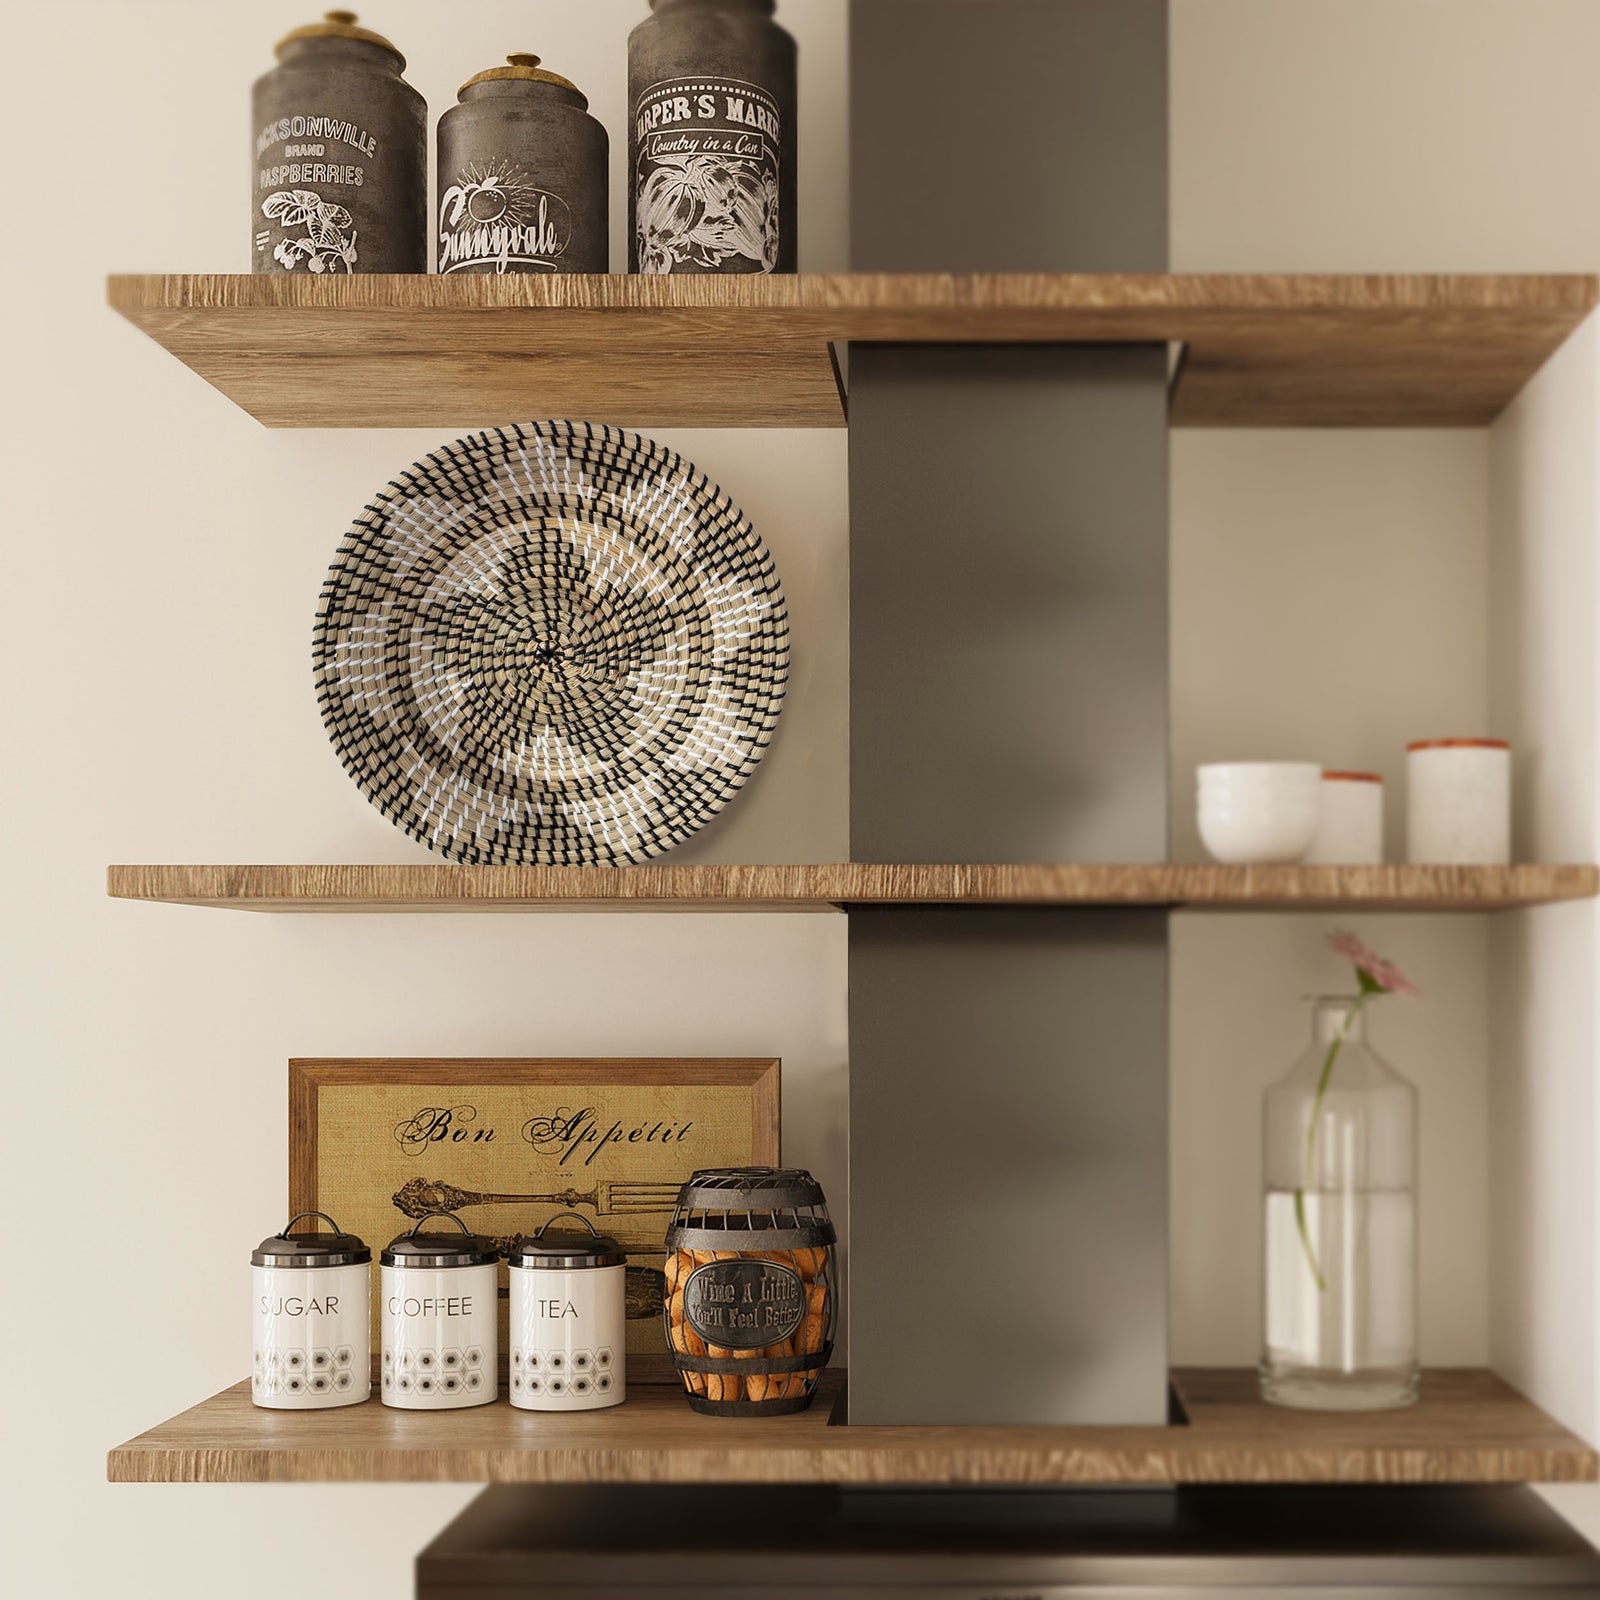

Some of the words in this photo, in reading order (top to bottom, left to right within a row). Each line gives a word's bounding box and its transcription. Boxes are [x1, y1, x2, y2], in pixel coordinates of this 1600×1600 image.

[284, 143, 325, 158] BRAND
[651, 134, 700, 156] Country
[702, 136, 720, 151] in
[722, 141, 734, 151] a
[735, 134, 759, 155] Can
[260, 163, 364, 190] RASPBERRIES
[439, 183, 558, 275] Sunnyvale
[394, 1104, 498, 1157] Bon
[521, 1106, 695, 1166] Appétit
[698, 1274, 735, 1304] Wine
[741, 1282, 754, 1303] A
[260, 1296, 339, 1317] SUGAR
[388, 1296, 473, 1318] COFFEE
[537, 1300, 579, 1319] TEA
[692, 1302, 724, 1328] You'll
[728, 1307, 760, 1329] Feel
[765, 1305, 799, 1328] Better
